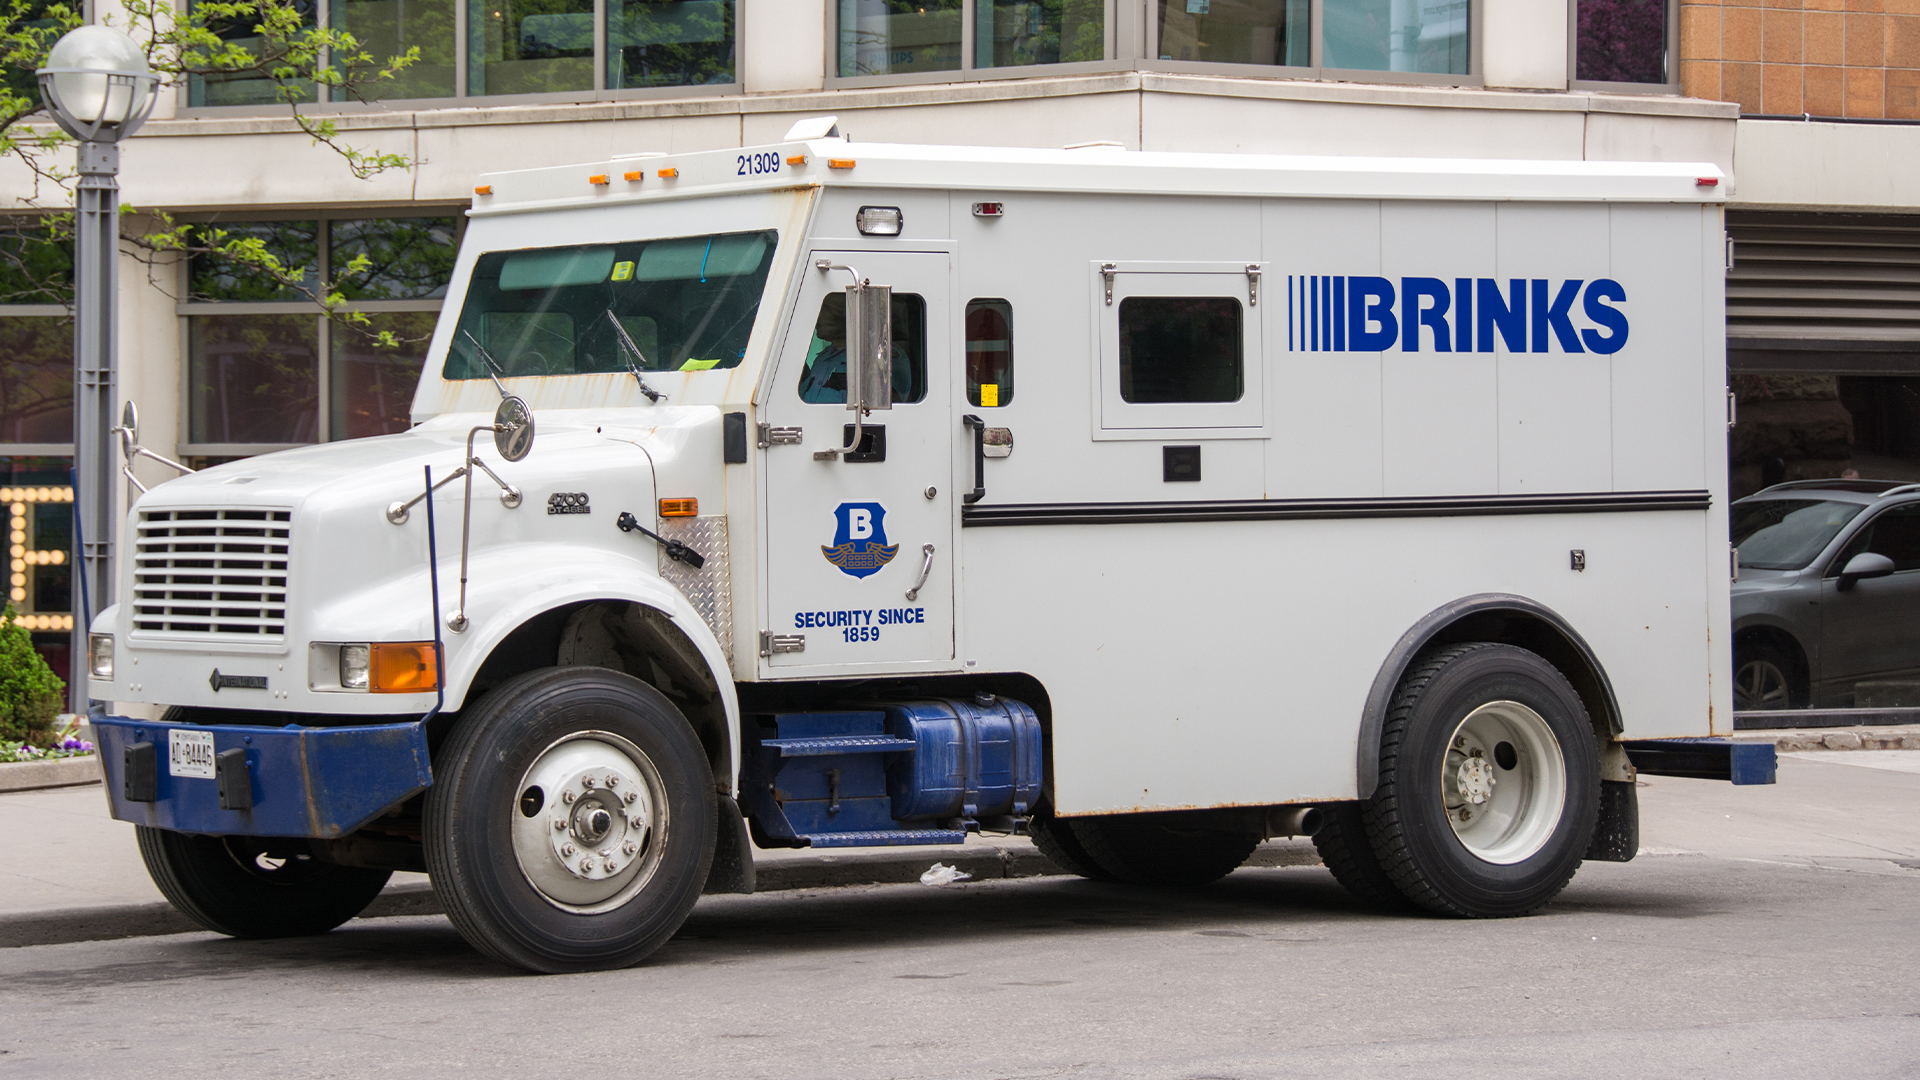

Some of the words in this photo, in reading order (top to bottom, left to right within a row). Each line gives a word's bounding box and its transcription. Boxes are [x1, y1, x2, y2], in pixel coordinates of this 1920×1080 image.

[870, 51, 914, 66] PHILIPS
[737, 151, 780, 176] 21309
[1347, 276, 1630, 355] BRINKS
[547, 492, 590, 506] 4700
[849, 508, 874, 540] B
[794, 609, 873, 629] SECURITY
[878, 607, 925, 625] SINCE
[842, 626, 880, 643] 1859
[172, 742, 181, 765] AD
[186, 743, 213, 767] 84446
